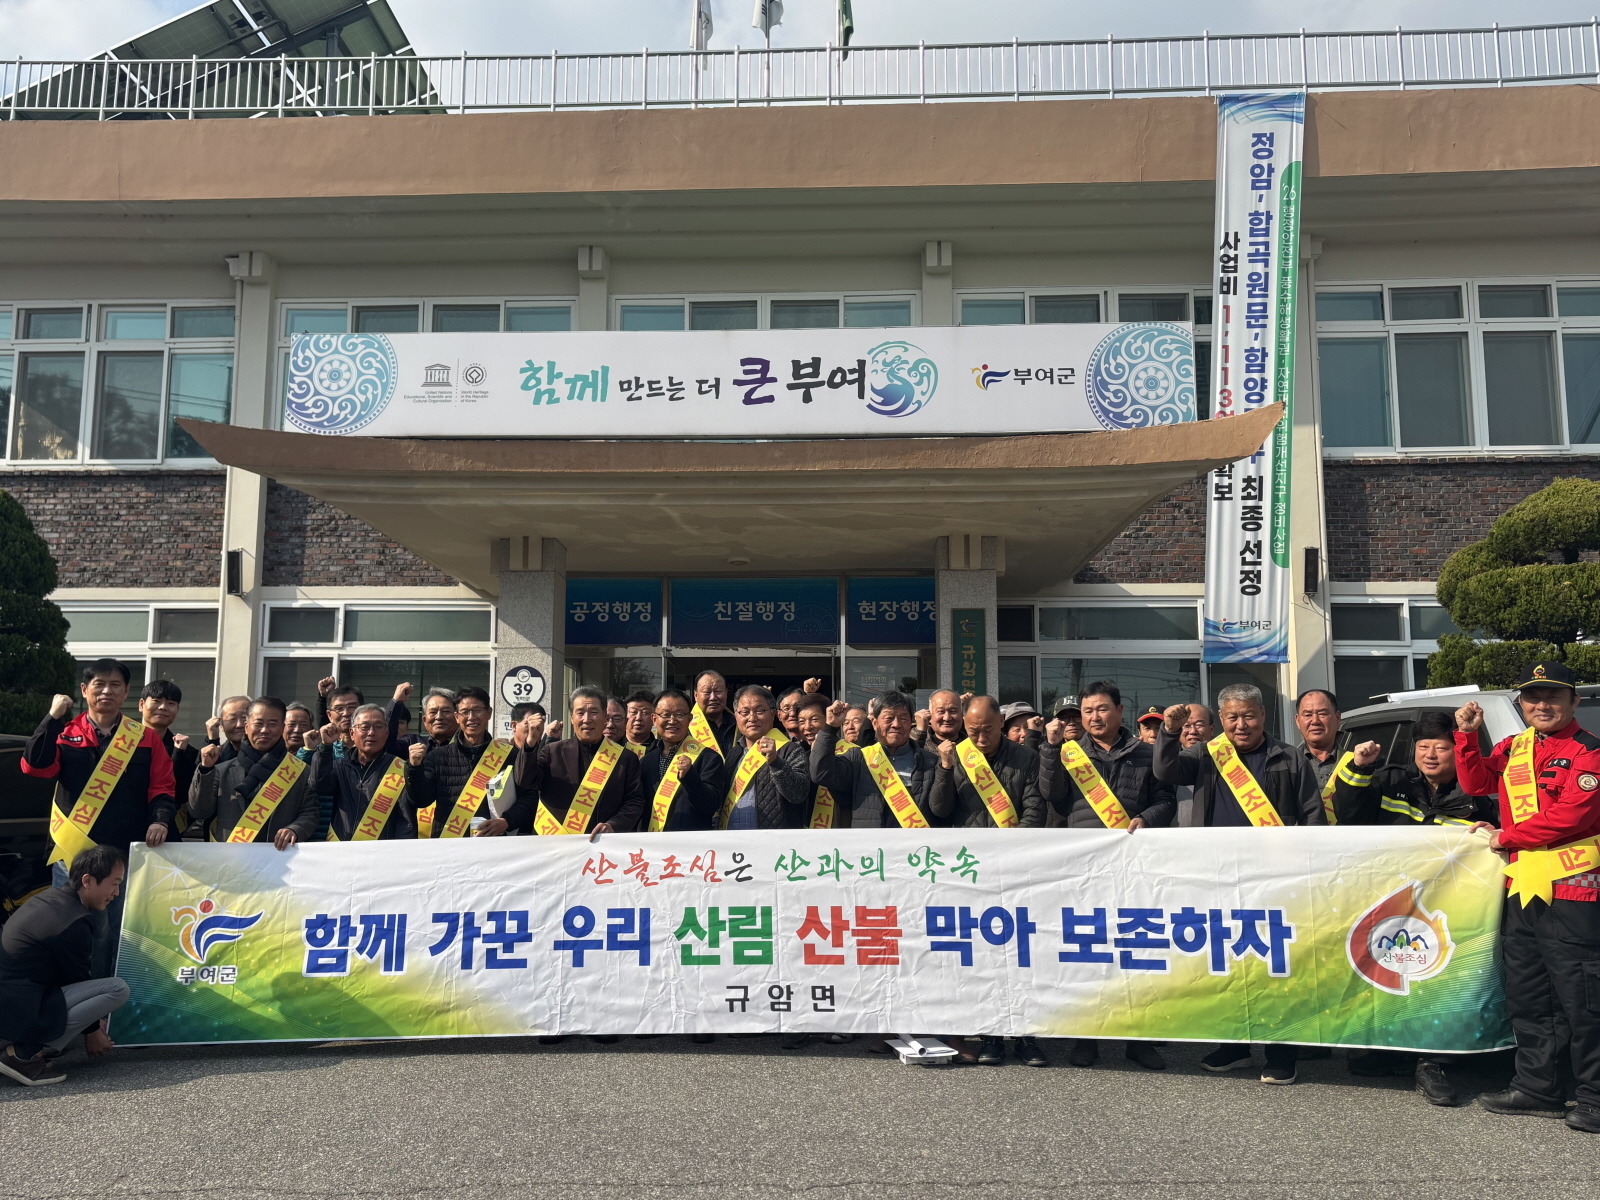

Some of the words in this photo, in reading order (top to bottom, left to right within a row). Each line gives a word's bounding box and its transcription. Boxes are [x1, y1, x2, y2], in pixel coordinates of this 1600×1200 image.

[1219, 231, 1241, 296] 사업비
[519, 358, 609, 406] 함께
[618, 375, 686, 403] 만드는
[696, 377, 721, 400] 더
[732, 357, 778, 406] 큰
[786, 356, 867, 404] 부여
[1013, 367, 1076, 386] 부여군
[1240, 475, 1264, 532] 최종
[1273, 502, 1286, 554] 정비사업
[1239, 539, 1263, 597] 선정
[569, 601, 652, 622] 공정행정
[713, 600, 796, 622] 친절행정
[857, 600, 937, 621] 현장행정
[1239, 620, 1272, 631] 부여군
[513, 683, 533, 696] 39
[72, 733, 136, 827] 산불조심
[447, 751, 503, 836] 산불조심
[566, 748, 617, 832] 산불조심
[581, 848, 754, 887] 산불조심은
[774, 847, 886, 882] 산과의
[907, 845, 980, 884] 약속
[305, 913, 408, 974] 함께
[428, 909, 533, 970] 가꾼
[553, 905, 651, 968] 우리
[673, 905, 774, 966] 산림
[795, 905, 903, 966] 산불
[925, 905, 1037, 968] 막아
[1058, 905, 1292, 974] 보존하자
[1381, 952, 1427, 965] 산불조심
[177, 965, 238, 983] 부여군
